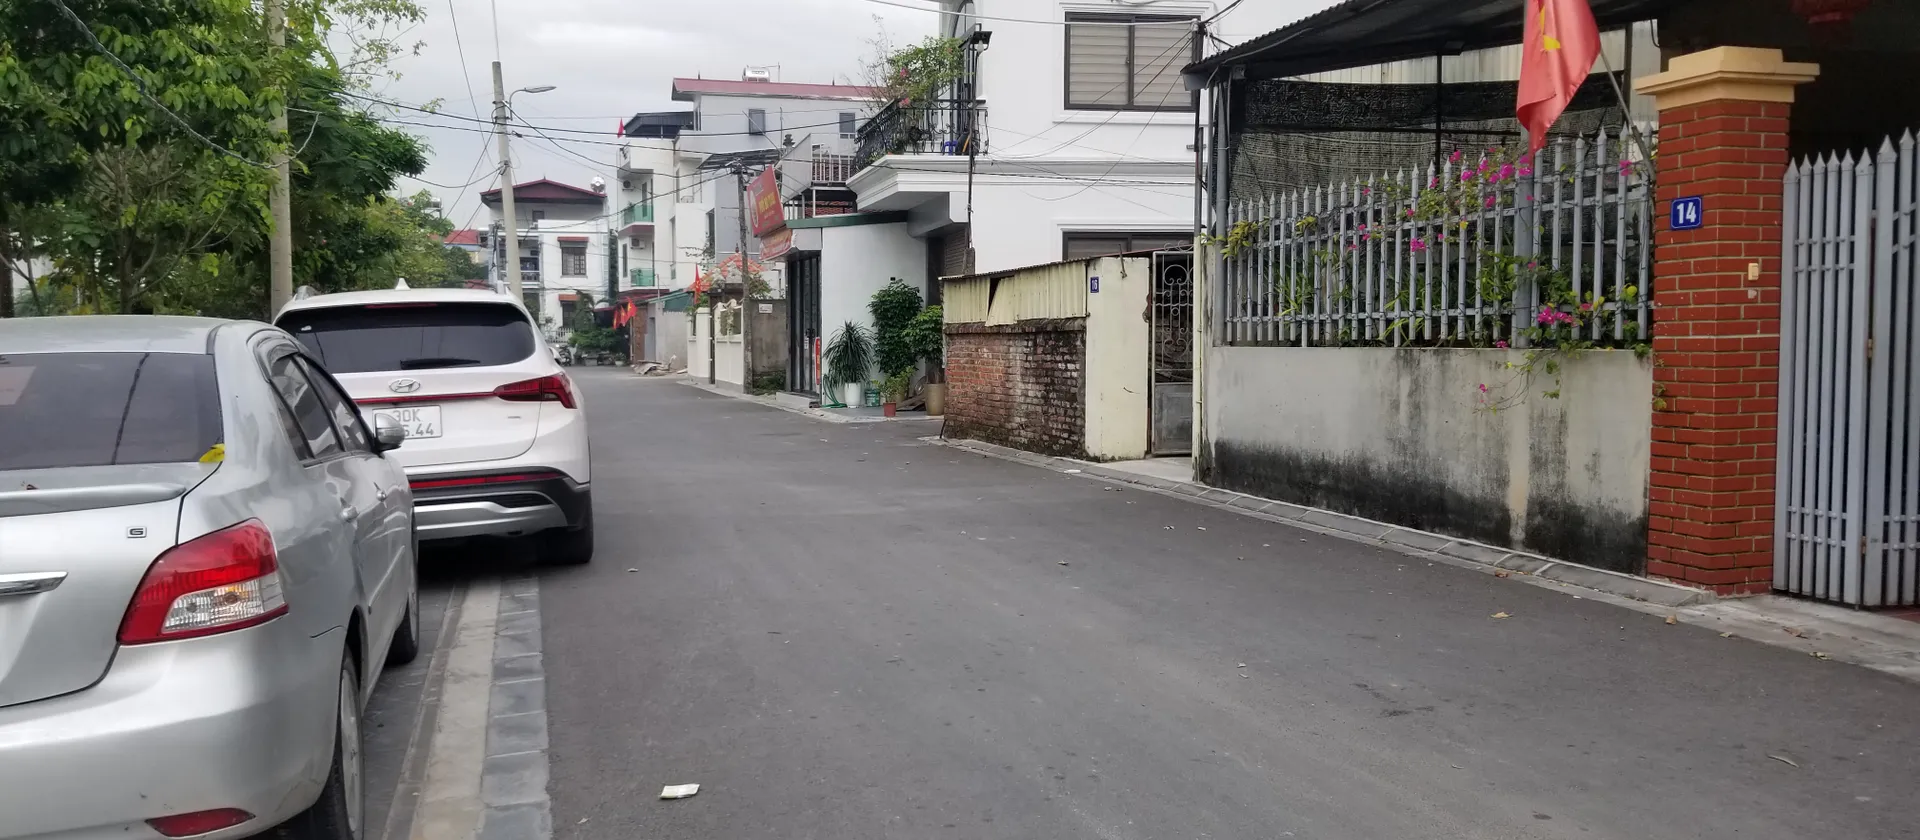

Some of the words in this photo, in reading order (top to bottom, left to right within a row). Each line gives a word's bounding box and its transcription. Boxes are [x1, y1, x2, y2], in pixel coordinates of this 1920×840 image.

[1676, 202, 1697, 224] 14
[1091, 279, 1098, 290] 16
[392, 409, 421, 422] 30K
[402, 423, 434, 437] 5.44
